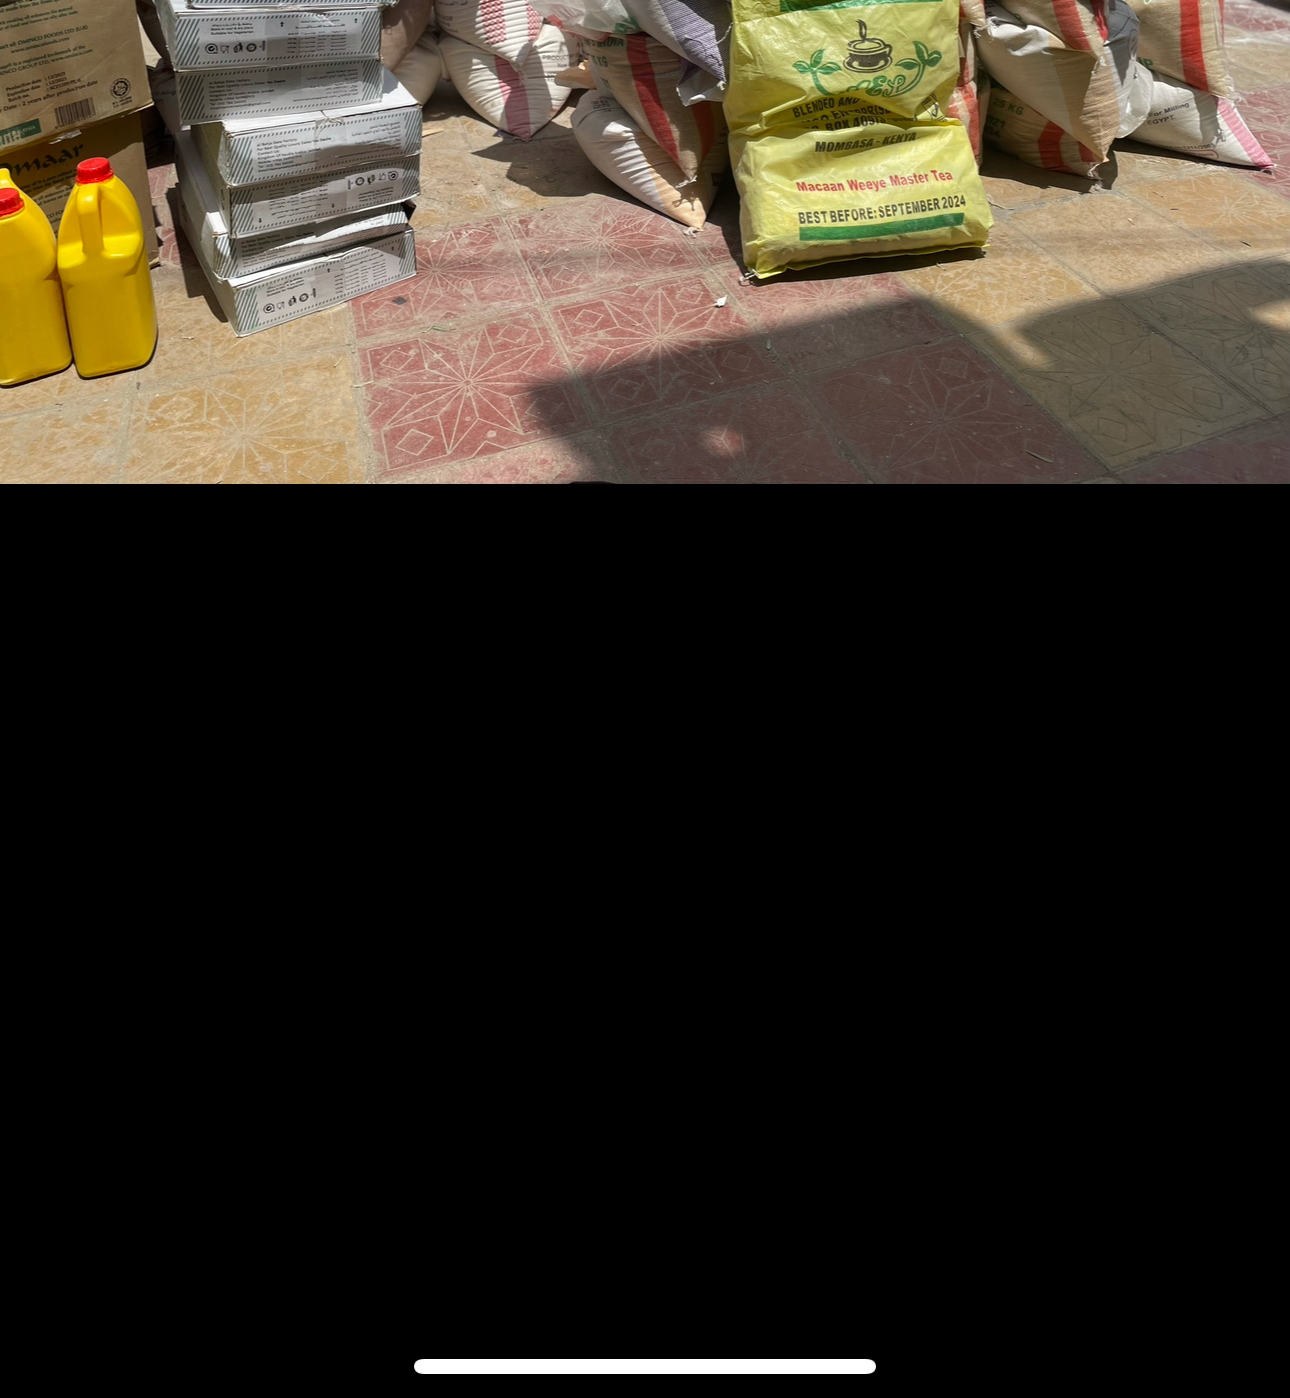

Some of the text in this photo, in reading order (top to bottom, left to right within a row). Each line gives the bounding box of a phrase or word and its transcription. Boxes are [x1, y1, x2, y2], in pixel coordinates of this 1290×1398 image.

[17, 35, 43, 46] OMINCO
[44, 31, 64, 39] FOODS
[64, 27, 75, 35] LTD
[17, 62, 38, 72] GROUP
[5, 80, 31, 92] Production
[6, 87, 31, 98] Expiration
[3, 104, 18, 112] Date
[27, 97, 42, 106] years
[43, 92, 56, 101] after
[56, 84, 86, 98] production
[86, 79, 98, 88] date
[8, 95, 22, 103] Batch
[992, 97, 1024, 116] 25 KG
[1164, 102, 1190, 114] Milling
[825, 119, 851, 132] BOX
[815, 132, 918, 153] MOMBASA KENYA
[796, 169, 954, 193] Macaan Weeye Master Tea
[798, 194, 967, 225] BEST BEFORE: SEPTEMBER 2024
